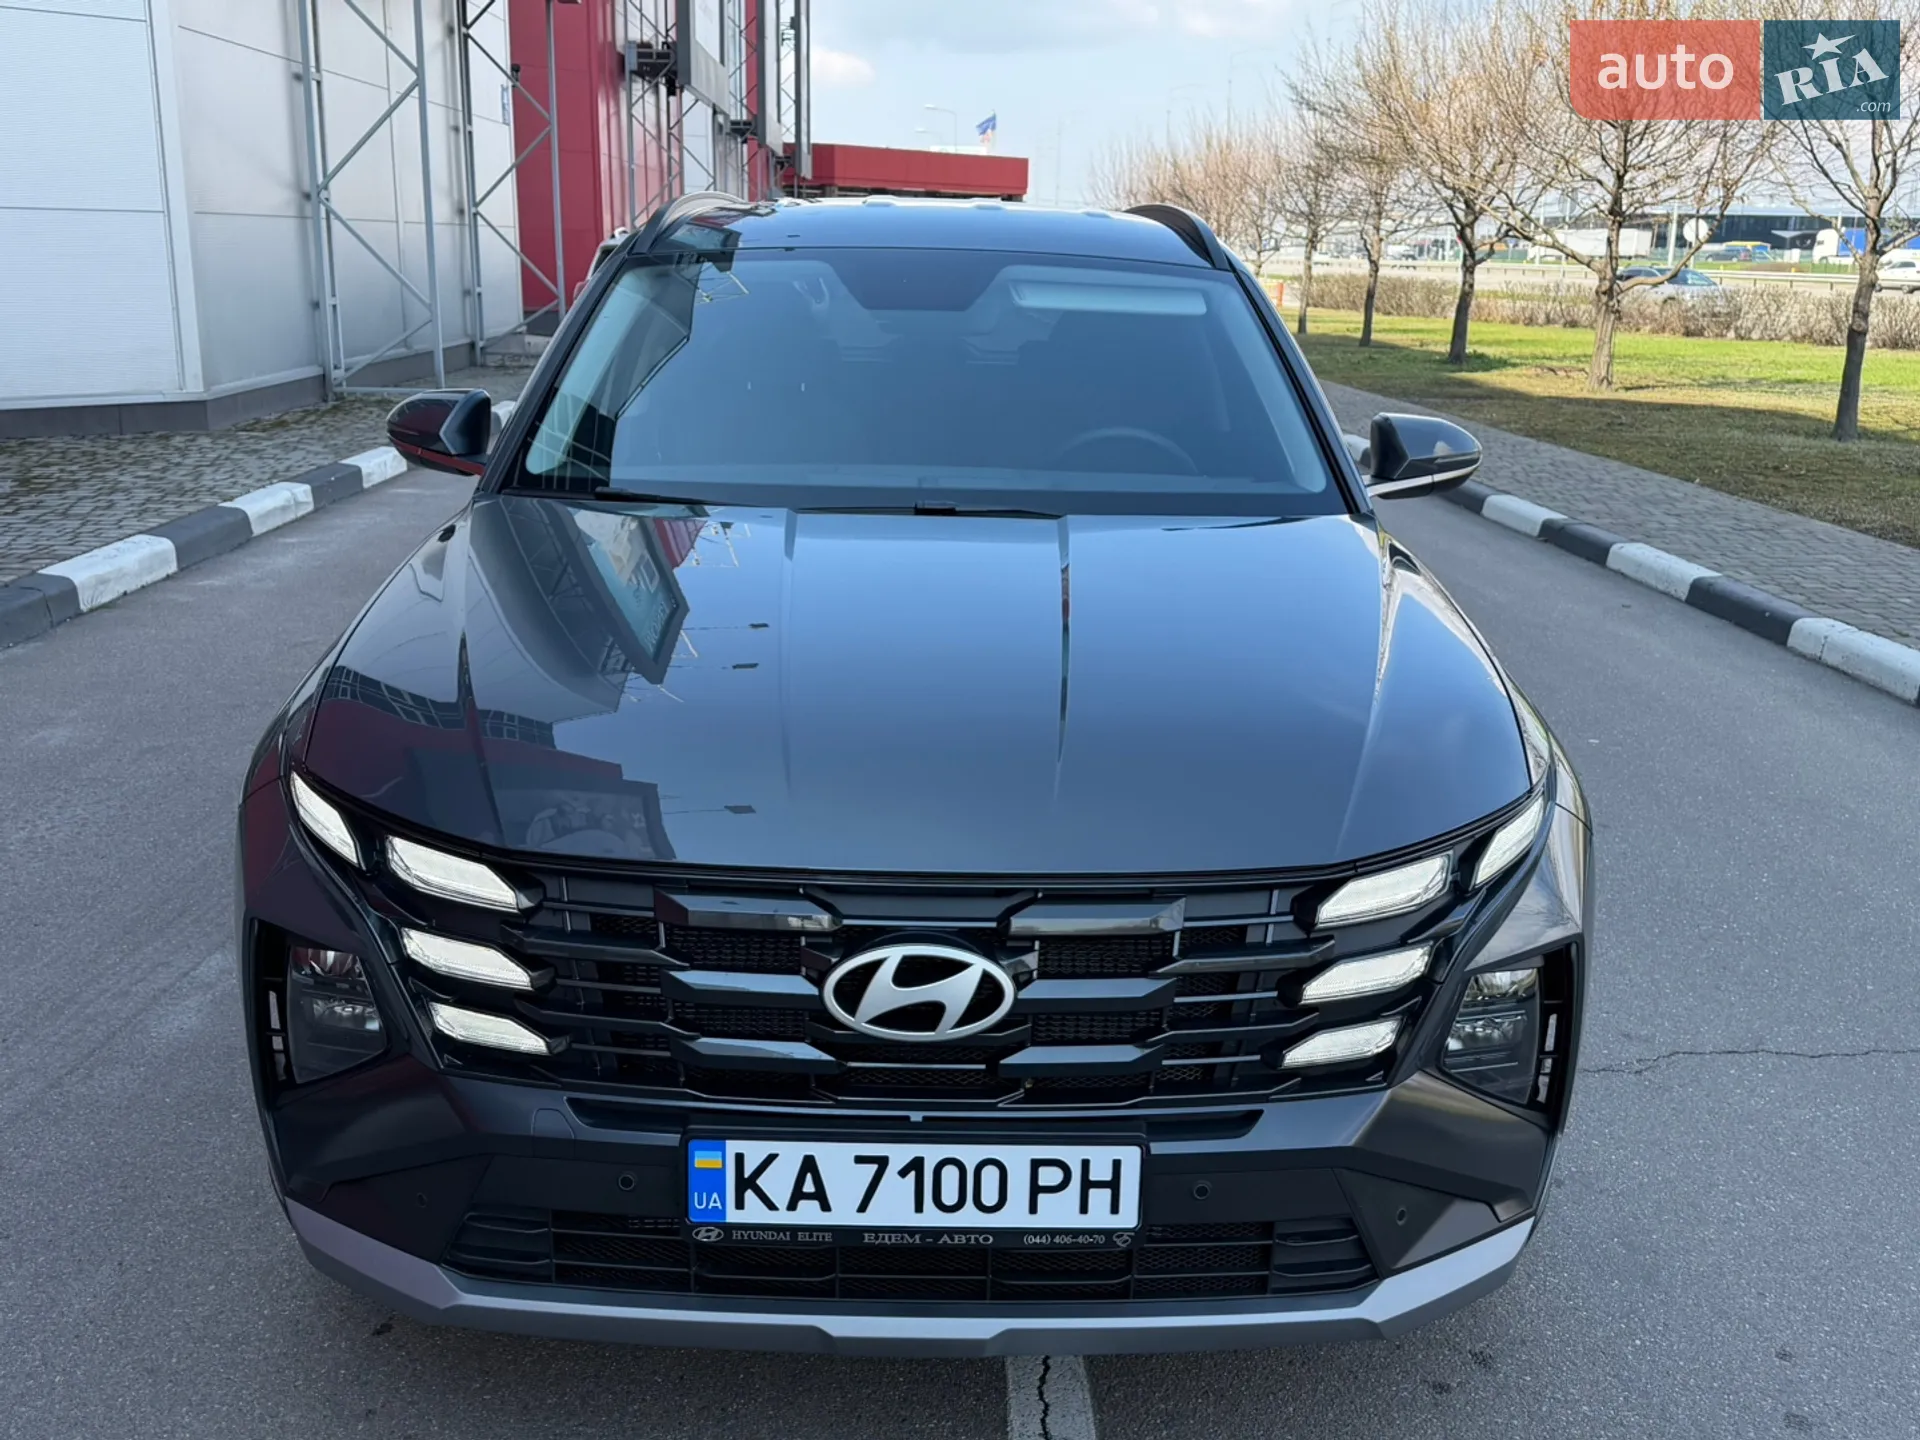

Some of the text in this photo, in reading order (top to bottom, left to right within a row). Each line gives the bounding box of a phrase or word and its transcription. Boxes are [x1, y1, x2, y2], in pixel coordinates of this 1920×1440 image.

[733, 1152, 1122, 1216] KA 7100 PH
[694, 1190, 722, 1210] UA
[732, 1230, 832, 1242] HYUNDAI ELITE
[863, 1232, 920, 1245] ЕДЕМ
[936, 1233, 993, 1245] АВТО
[1023, 1233, 1106, 1245] (044) 406-40-70
